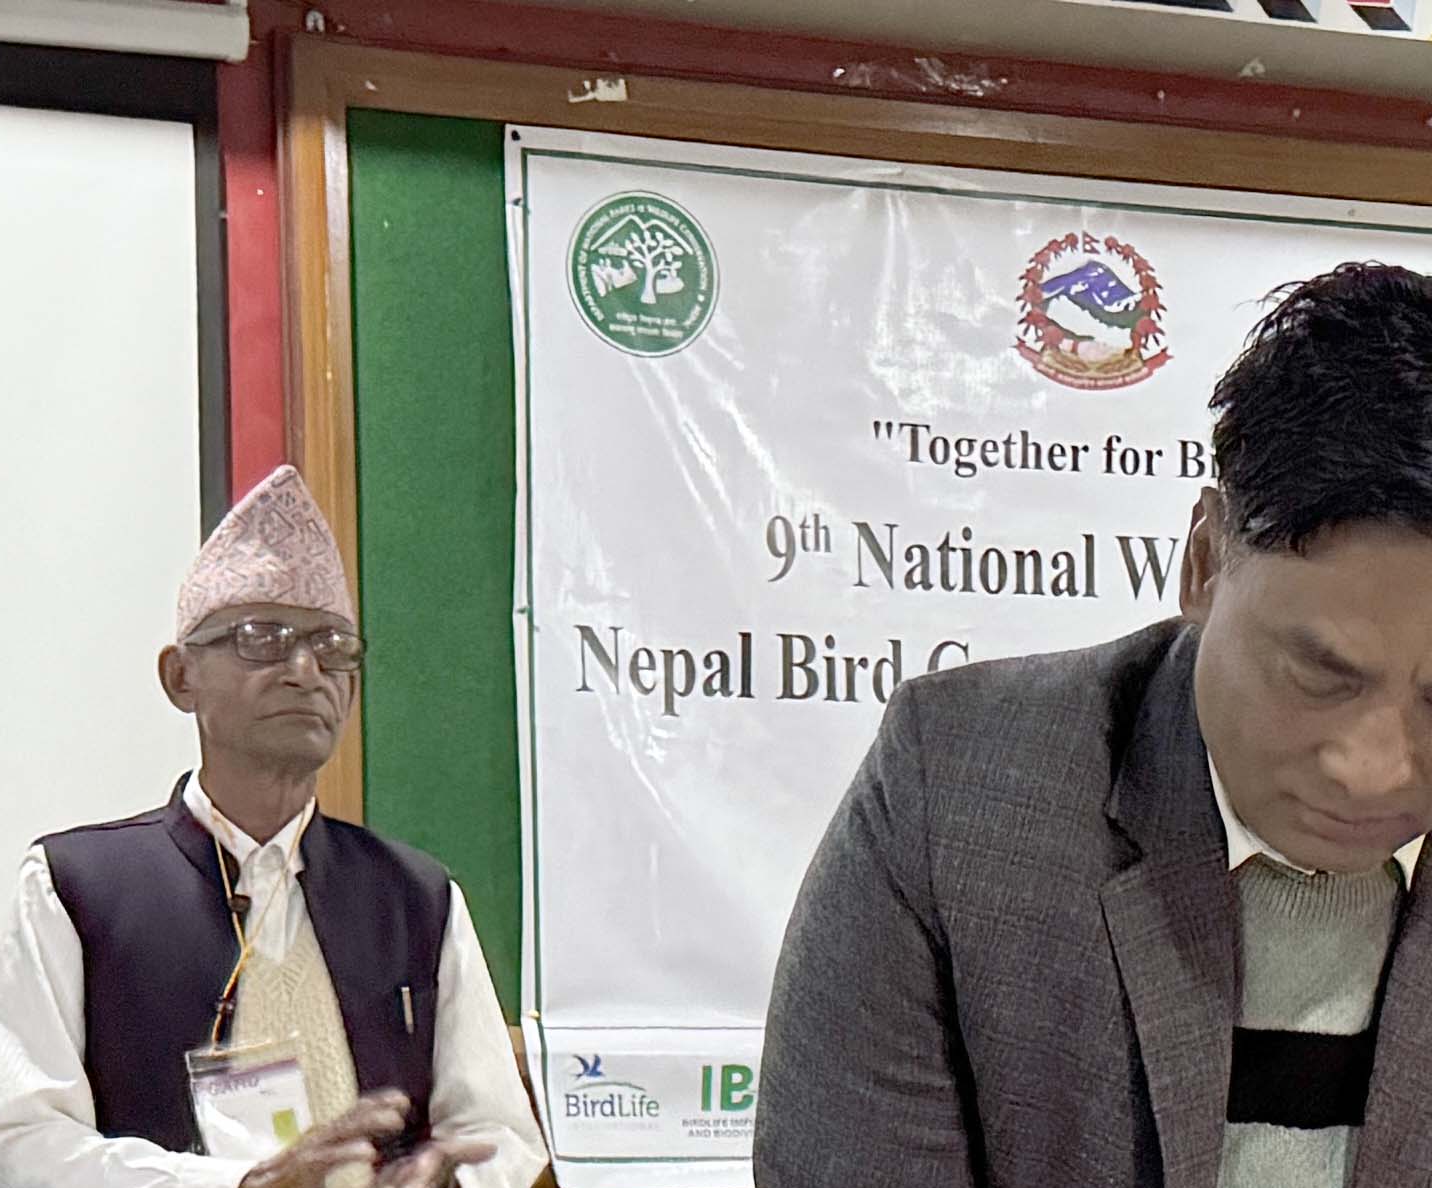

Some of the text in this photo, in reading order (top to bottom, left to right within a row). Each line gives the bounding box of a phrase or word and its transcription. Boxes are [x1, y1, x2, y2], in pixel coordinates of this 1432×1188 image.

[872, 420, 1218, 479] "Together for Bi
[767, 513, 1180, 601] 9th National W
[573, 624, 903, 718] Nepal Bird
[564, 1092, 660, 1118] BirdLife
[701, 1063, 755, 1112] IB
